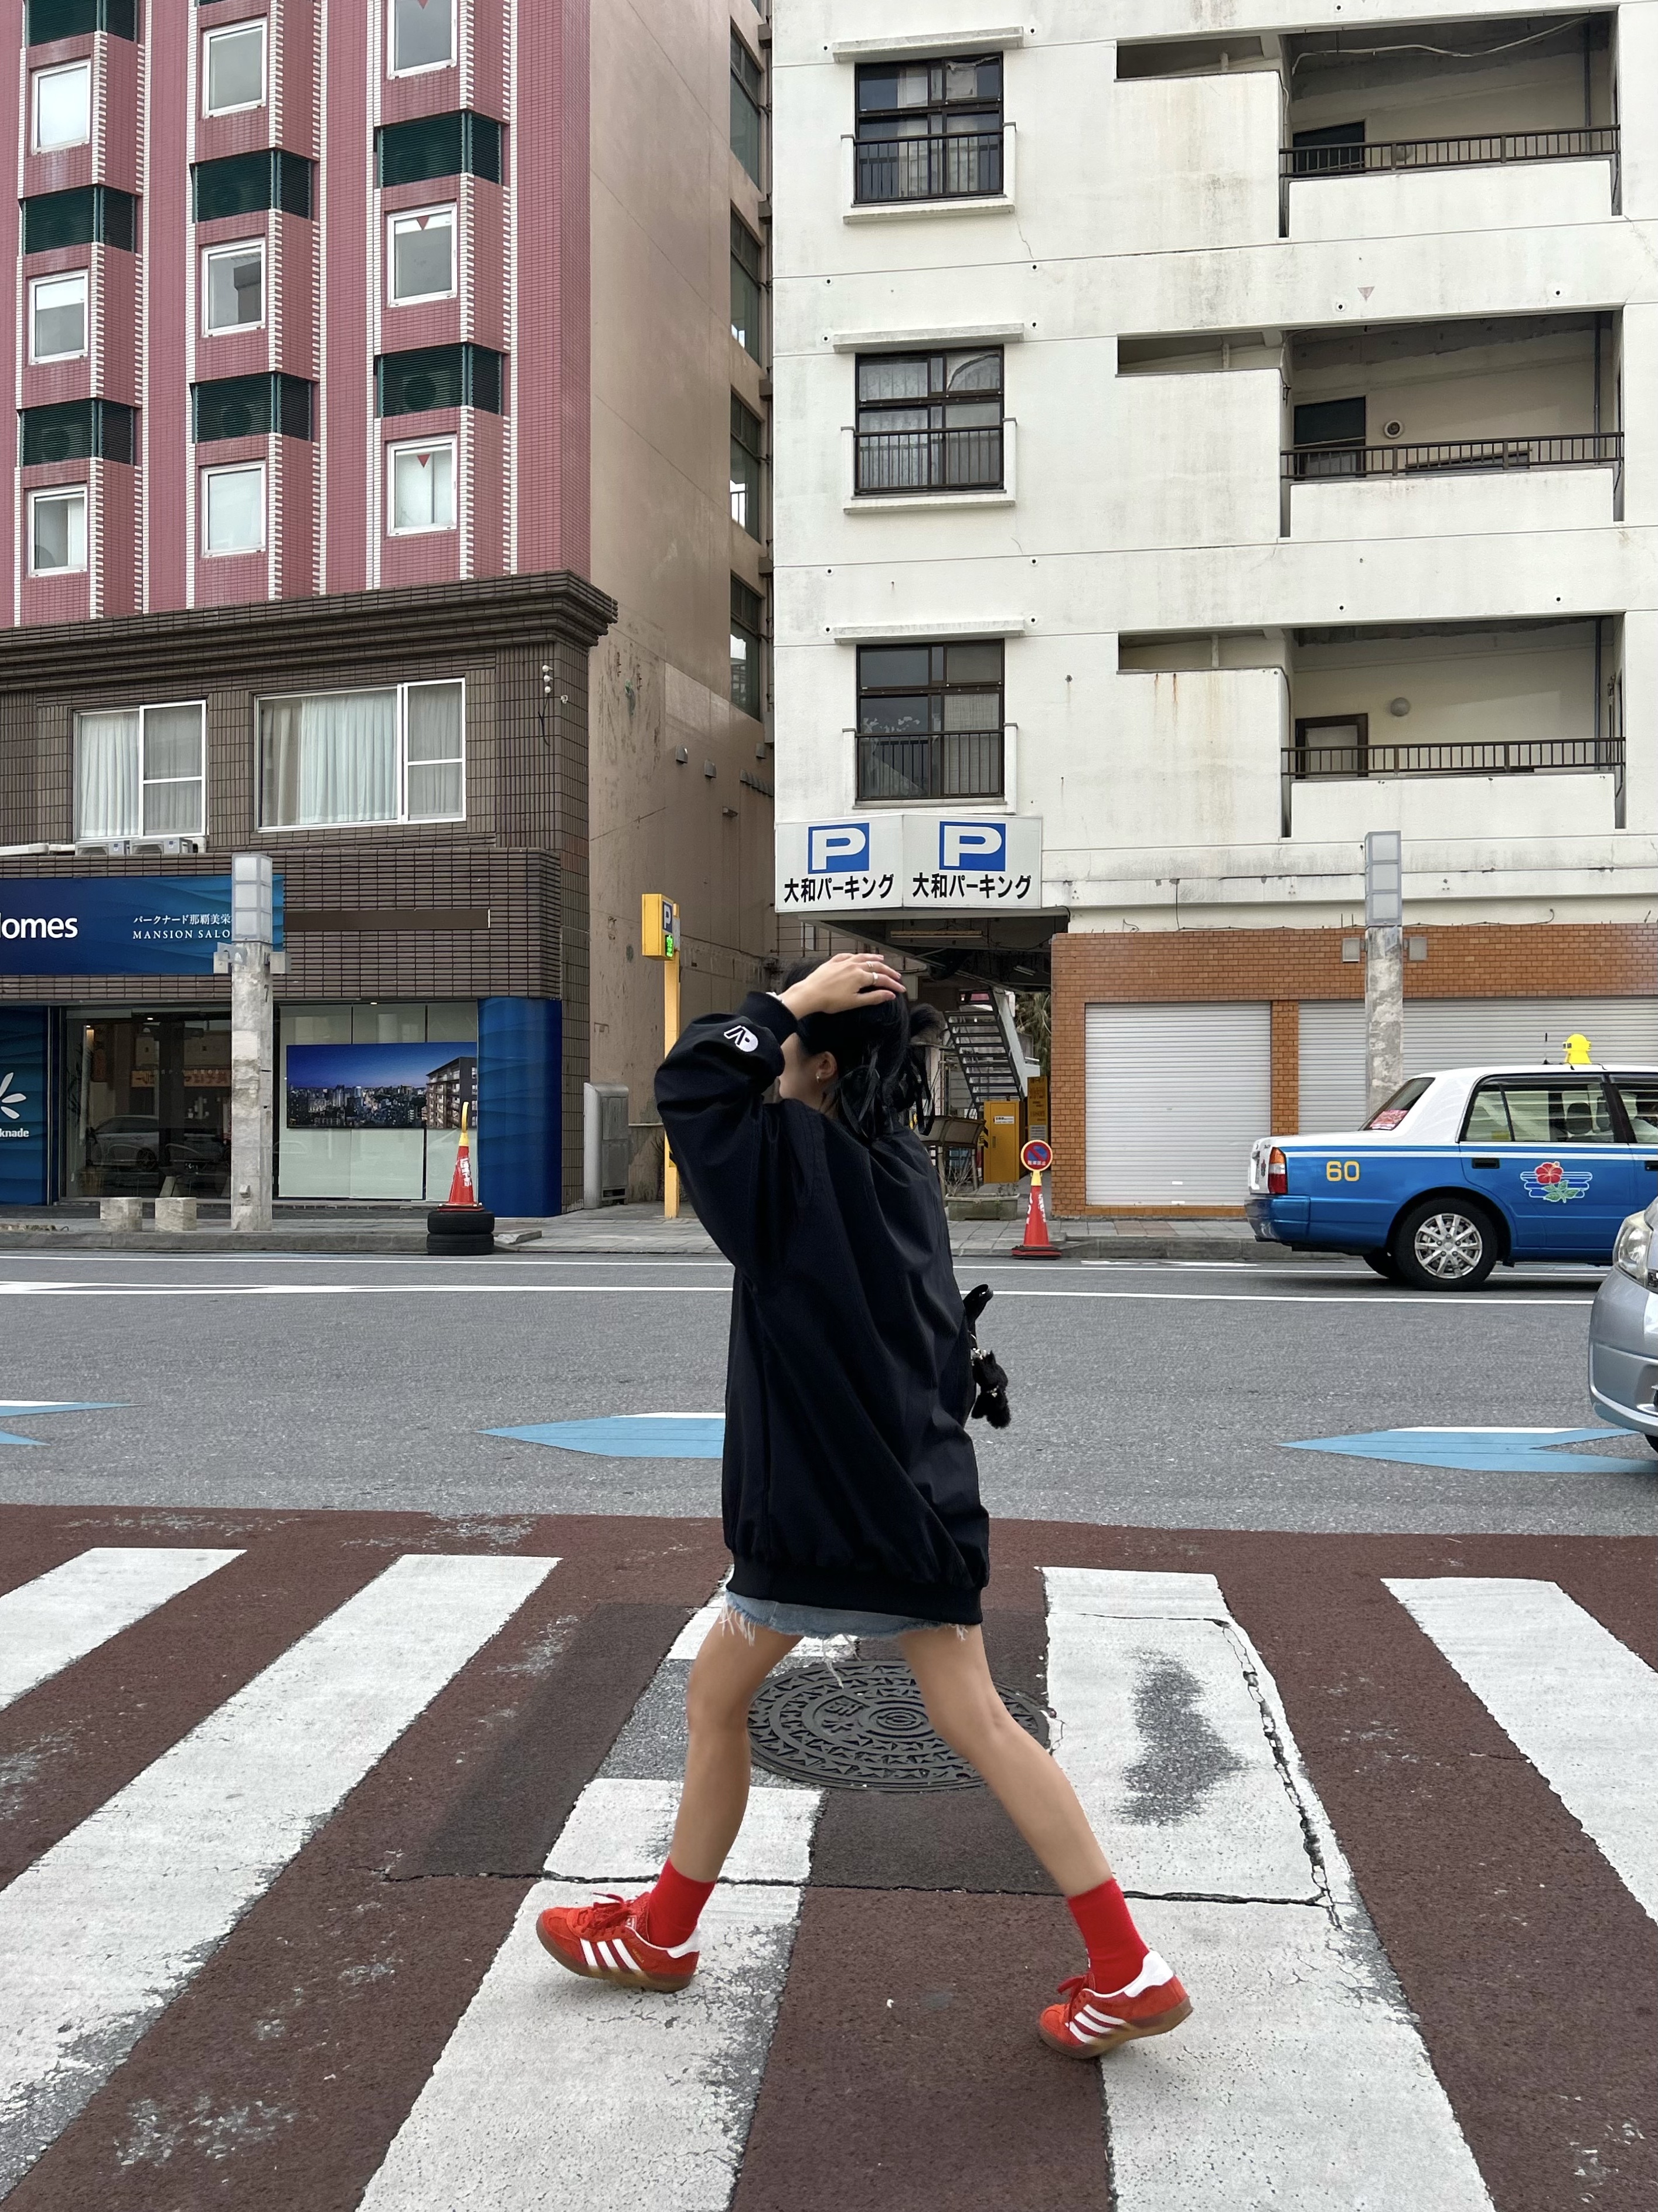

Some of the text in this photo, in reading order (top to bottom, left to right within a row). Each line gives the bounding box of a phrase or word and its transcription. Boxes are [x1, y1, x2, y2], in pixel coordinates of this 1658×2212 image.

[812, 828, 866, 870] P
[944, 825, 1002, 867] P
[784, 874, 894, 903] 大和パーキング
[913, 872, 1031, 899] 大和パーキング
[0, 912, 79, 939] omes
[133, 913, 232, 925] パークナード那覇美栄
[132, 929, 193, 939] MANSION
[1326, 1161, 1360, 1181] 60
